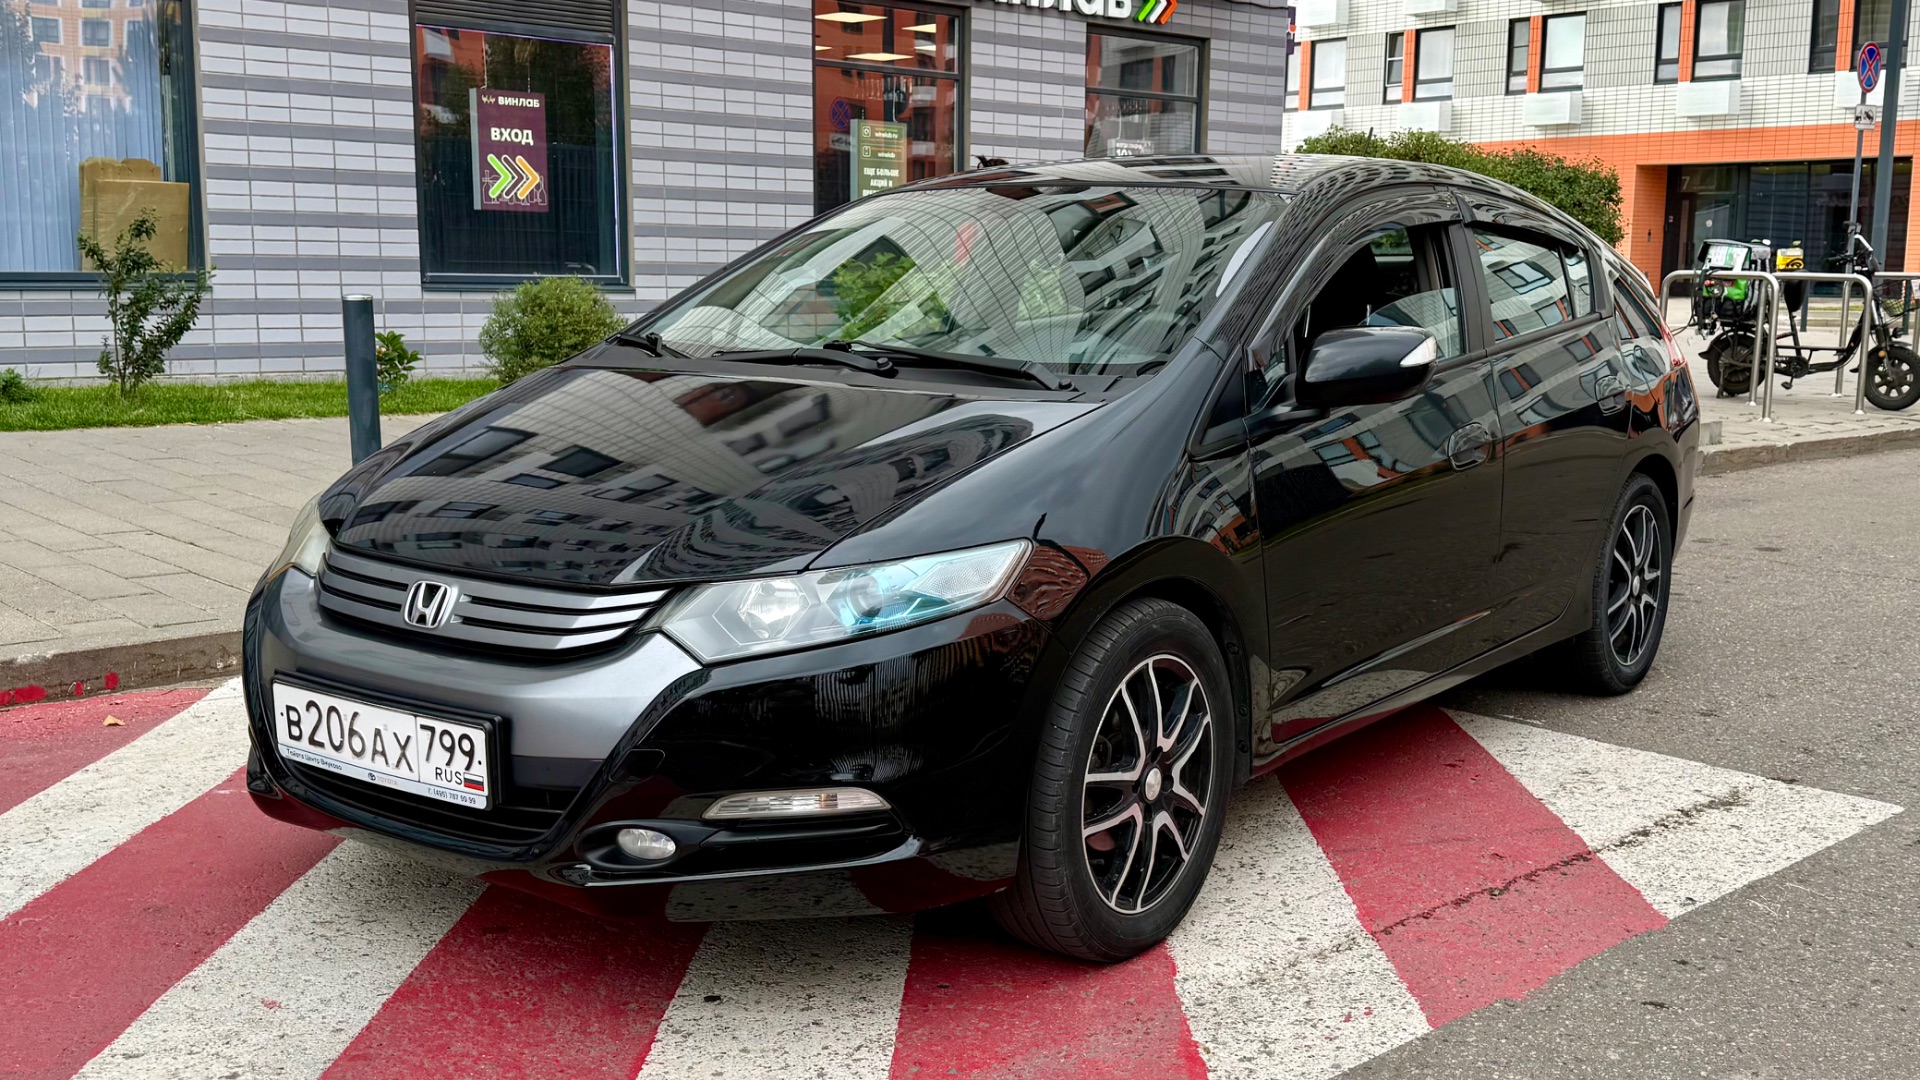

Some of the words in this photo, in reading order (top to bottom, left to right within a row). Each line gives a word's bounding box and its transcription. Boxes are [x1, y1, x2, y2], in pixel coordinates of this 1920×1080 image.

[490, 127, 534, 146] ВХОД
[419, 724, 476, 771] 799
[434, 766, 463, 786] RUS
